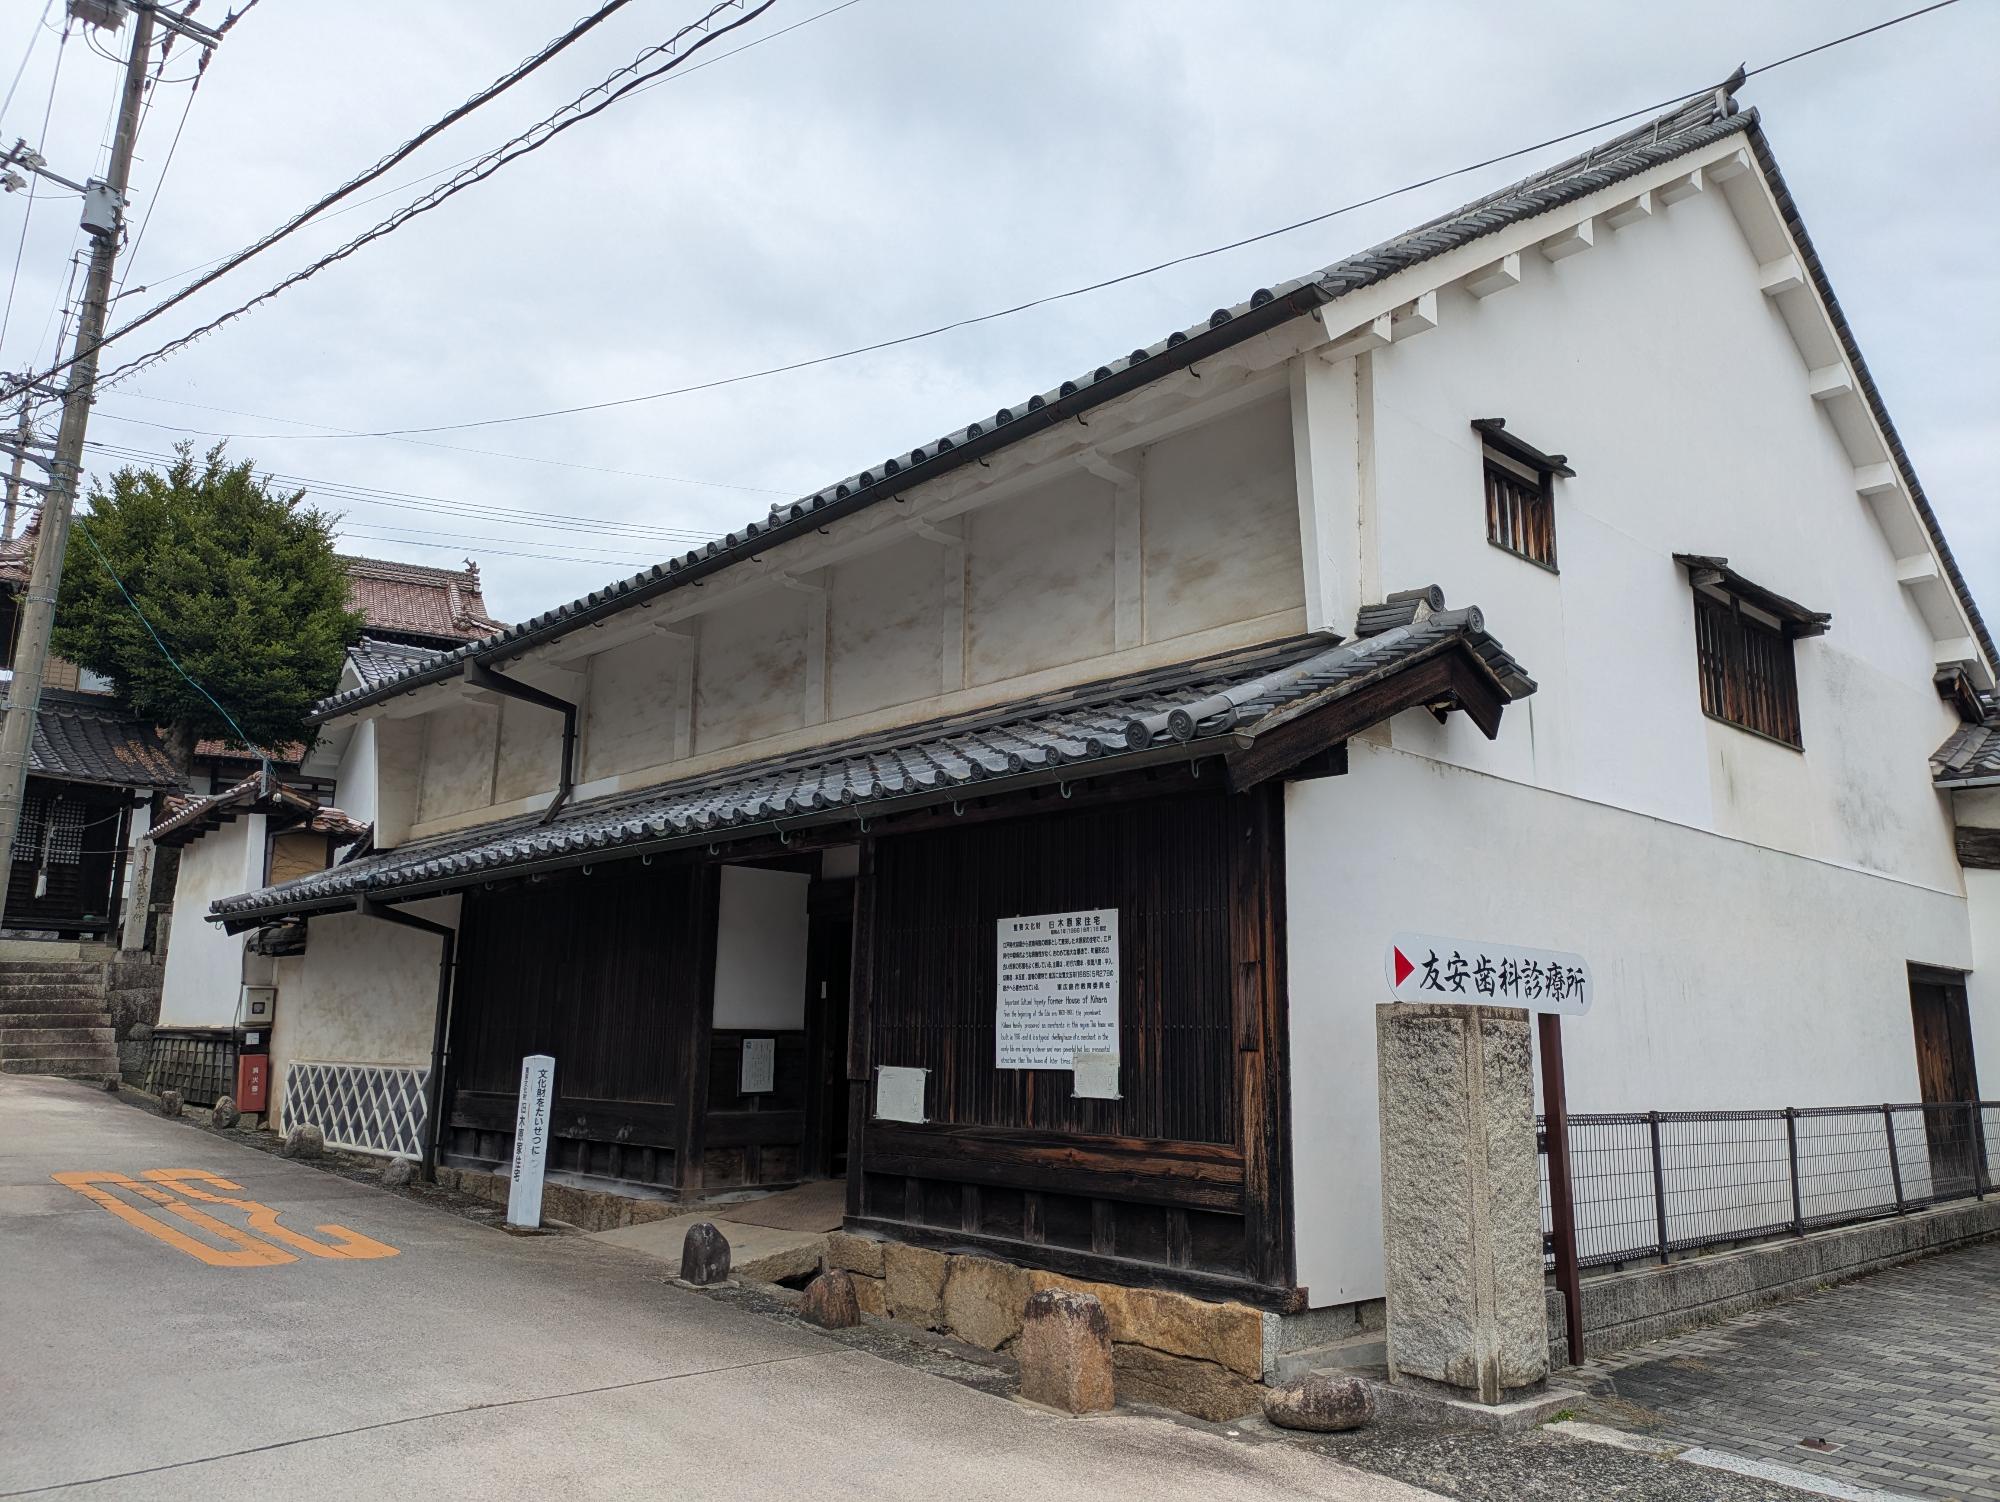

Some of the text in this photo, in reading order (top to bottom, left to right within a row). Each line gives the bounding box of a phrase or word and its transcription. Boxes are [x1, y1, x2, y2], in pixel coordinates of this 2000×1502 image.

[1047, 995, 1063, 1005] Former
[1065, 995, 1080, 1004] House
[1090, 994, 1108, 1004] Kihara
[1420, 949, 1586, 1005] 友安歯科診療所
[531, 1068, 549, 1155] 文化財をたいせつに
